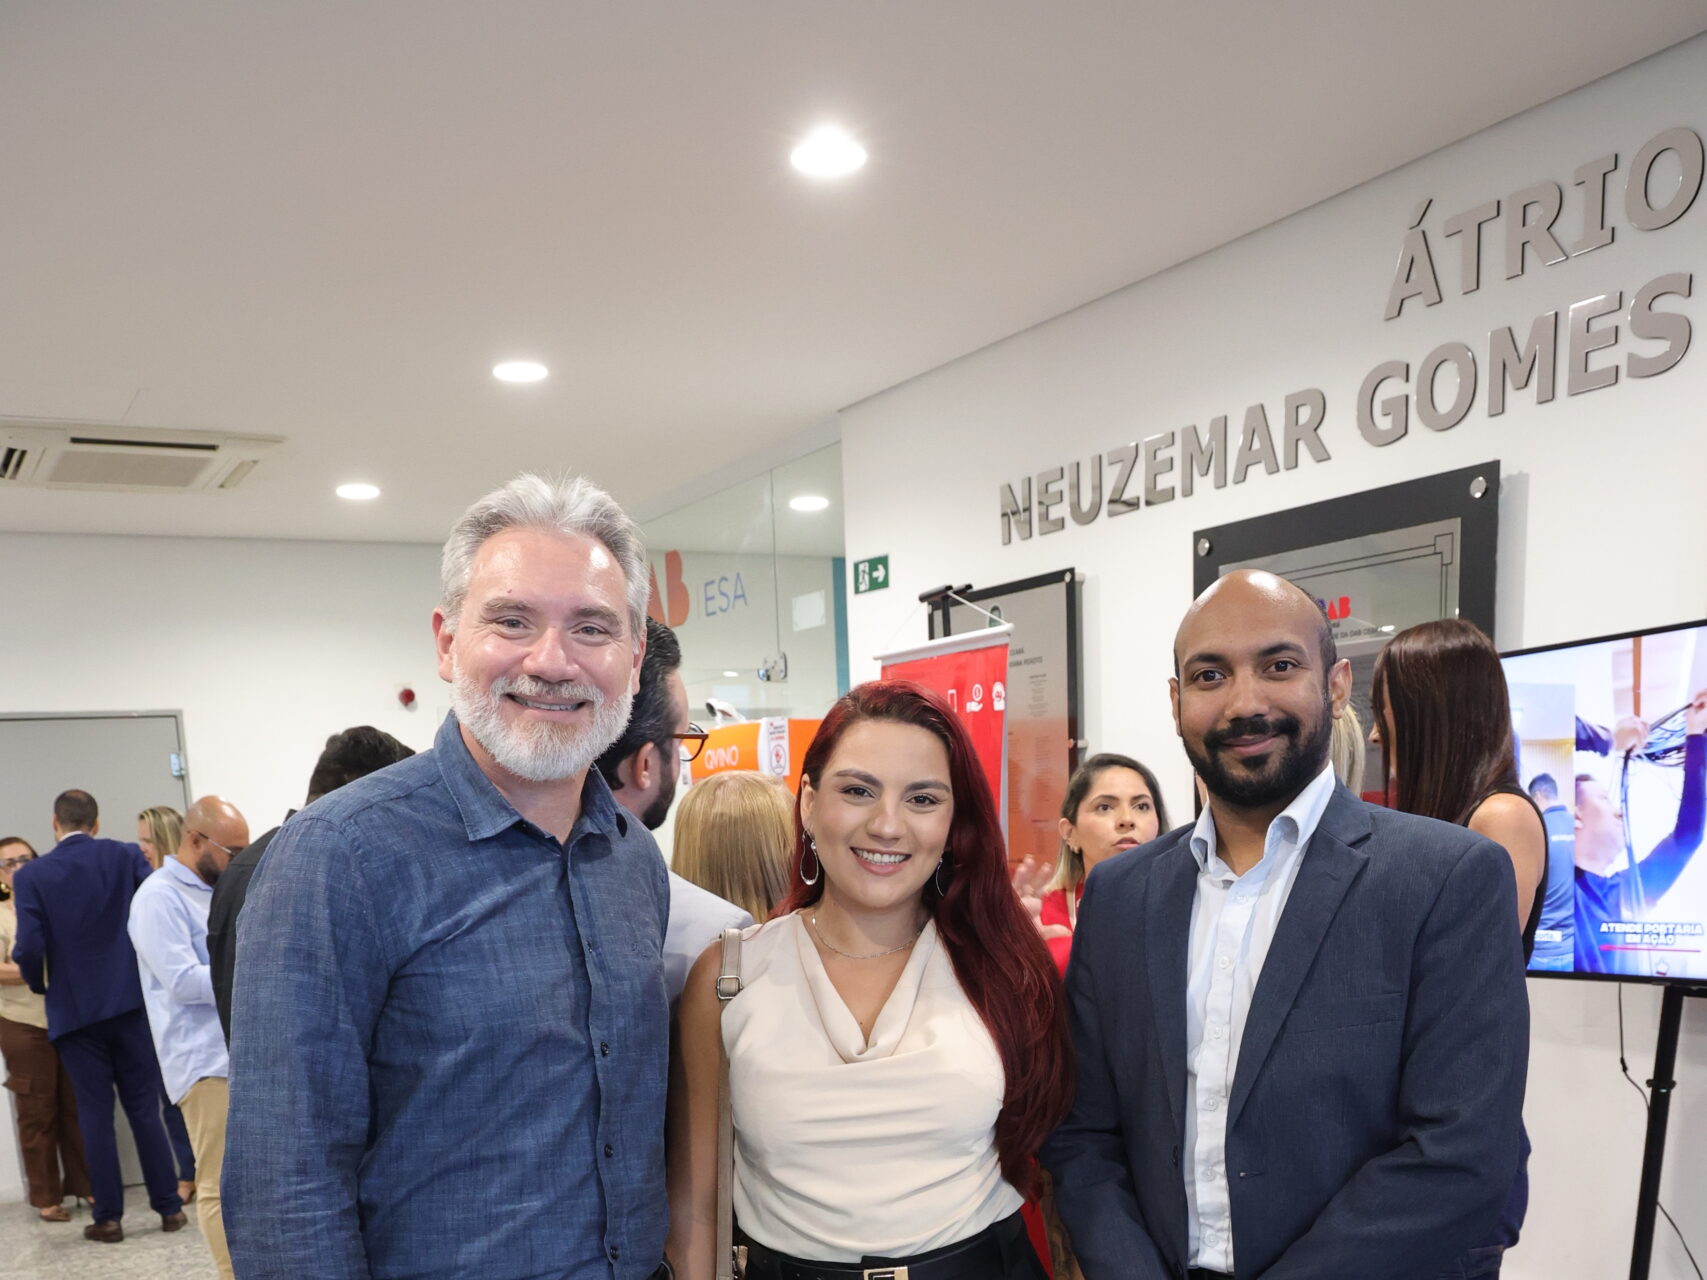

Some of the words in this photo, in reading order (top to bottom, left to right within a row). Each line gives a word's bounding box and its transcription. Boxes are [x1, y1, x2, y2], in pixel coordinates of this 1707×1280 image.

[1383, 127, 1705, 321] ÁTRIO
[1000, 387, 1332, 547] NEUZEMAR
[1355, 272, 1693, 447] GOMES
[703, 571, 748, 617] ESA
[1643, 923, 1703, 935] PORTARIA
